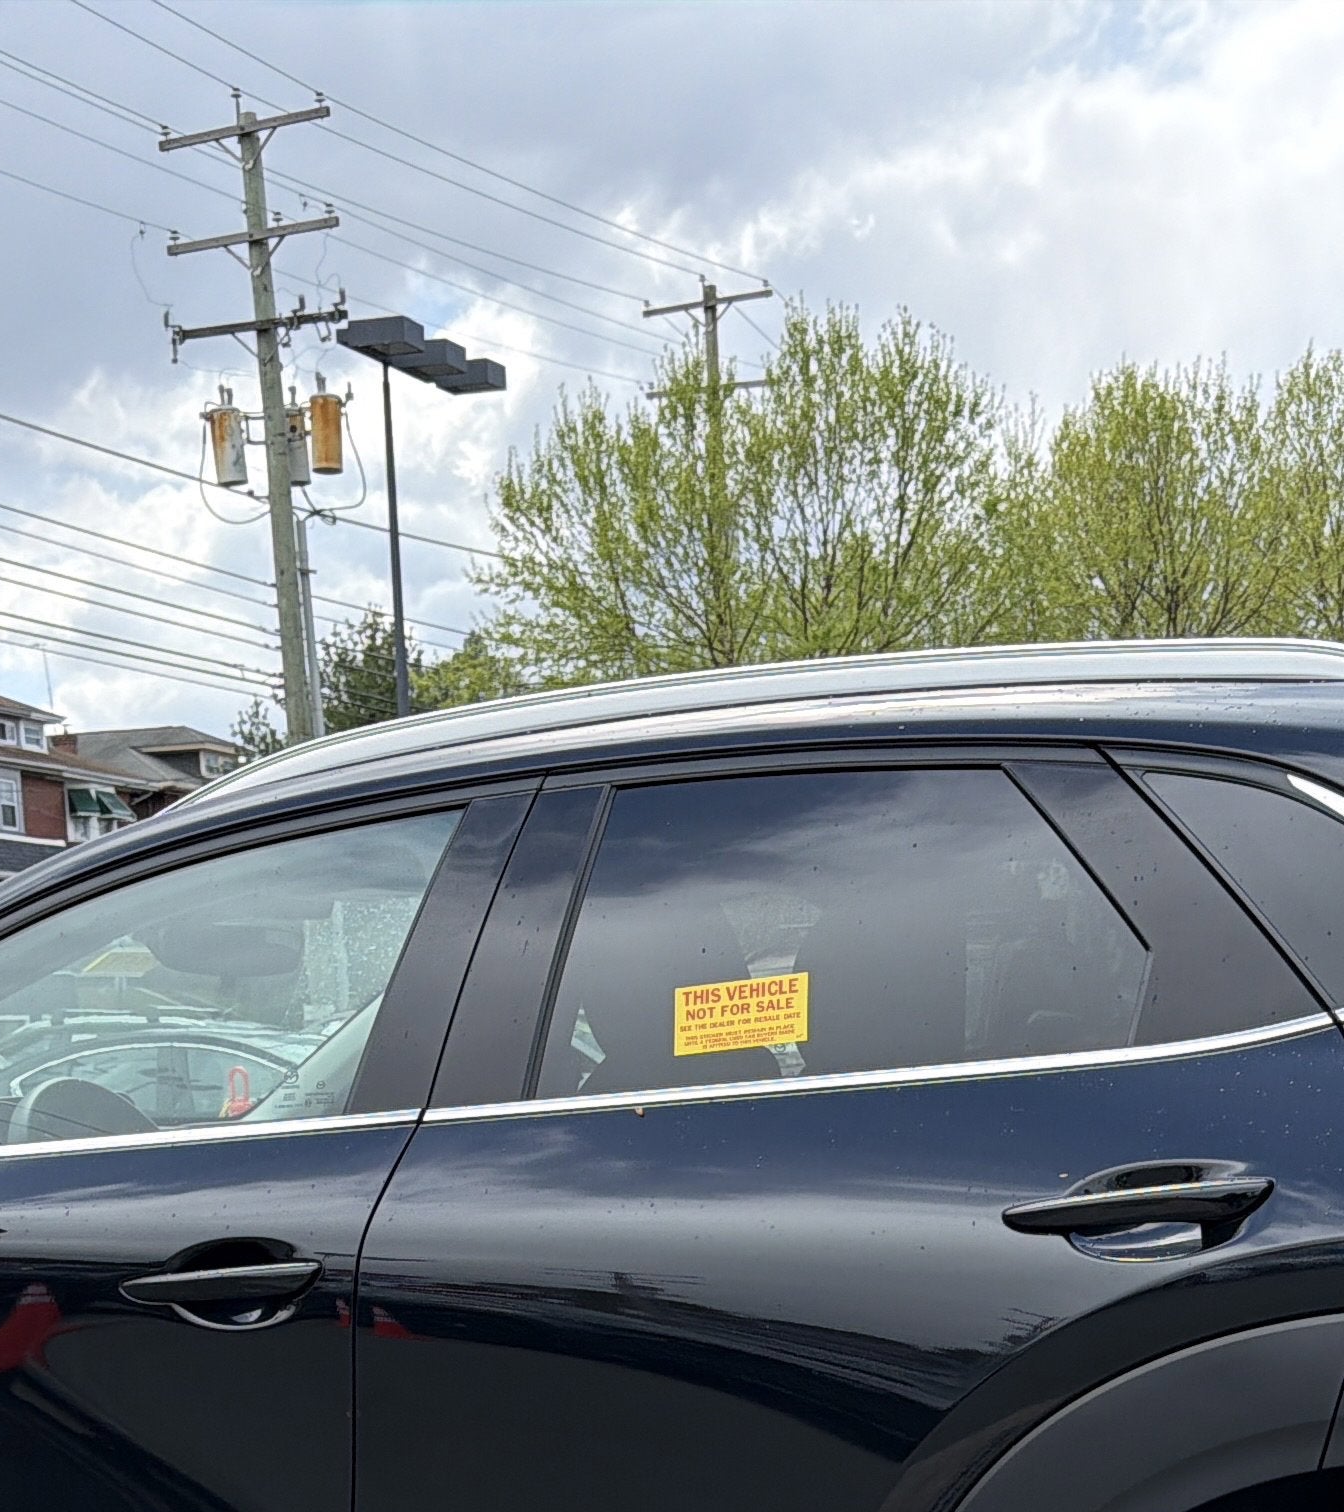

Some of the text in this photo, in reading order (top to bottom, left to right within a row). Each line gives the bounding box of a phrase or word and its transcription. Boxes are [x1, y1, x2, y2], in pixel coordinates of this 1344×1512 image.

[682, 977, 799, 1007] THIS VEHICLE
[686, 997, 795, 1021] NOT FOR SALE
[695, 1023, 707, 1031] THE
[709, 1019, 735, 1029] DEALER
[754, 1014, 780, 1023] RESALE
[783, 1011, 801, 1019] DATE
